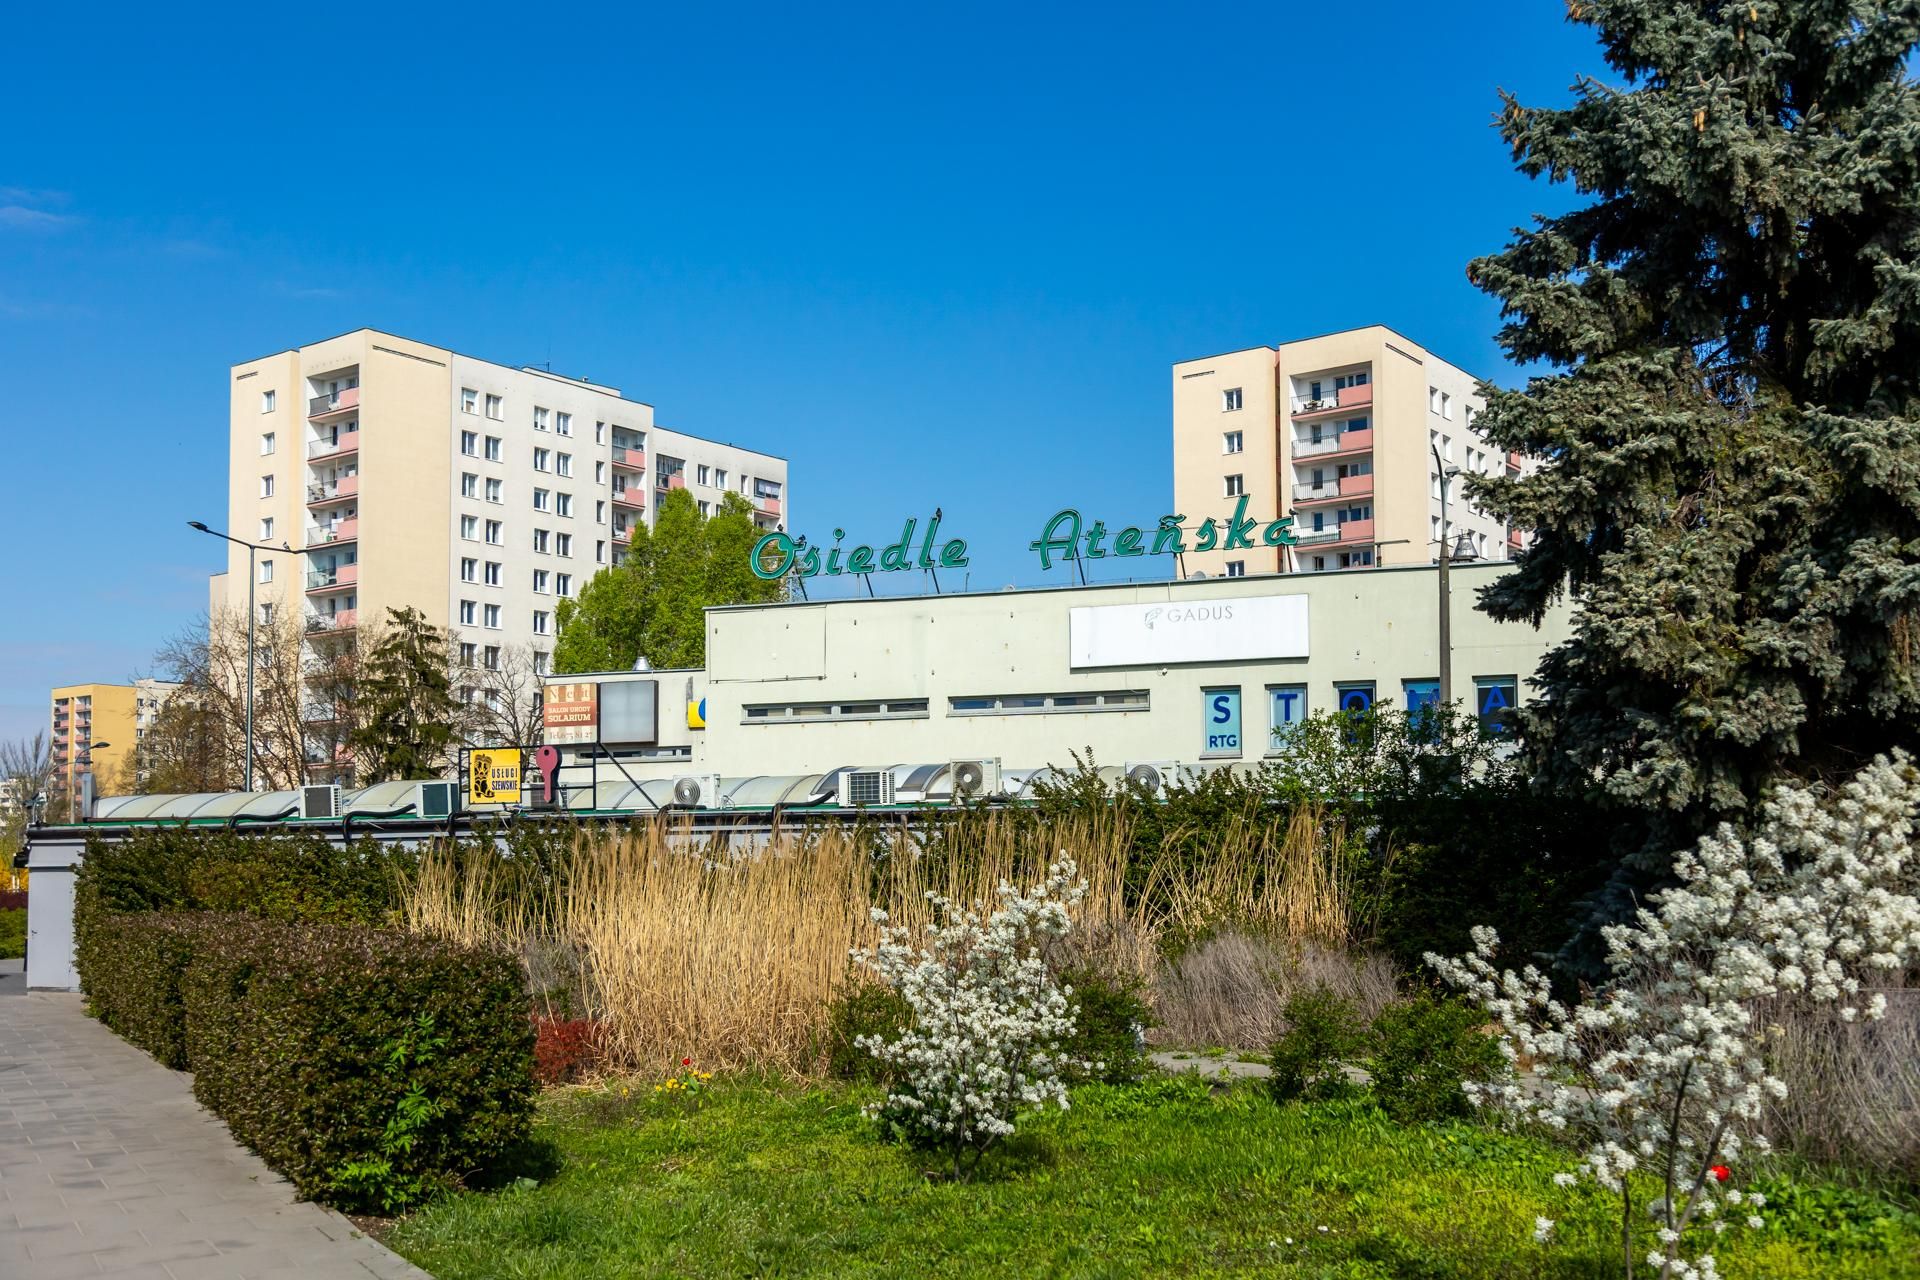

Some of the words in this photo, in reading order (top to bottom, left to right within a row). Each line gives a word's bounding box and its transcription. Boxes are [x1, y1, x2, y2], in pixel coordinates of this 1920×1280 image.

[750, 517, 969, 580] Osiedle
[1167, 605, 1233, 622] GADUS
[547, 713, 592, 723] SOLARIUM
[1209, 734, 1237, 748] RTG
[491, 767, 518, 779] USŁUGI
[491, 779, 518, 791] SZEWSKIE
